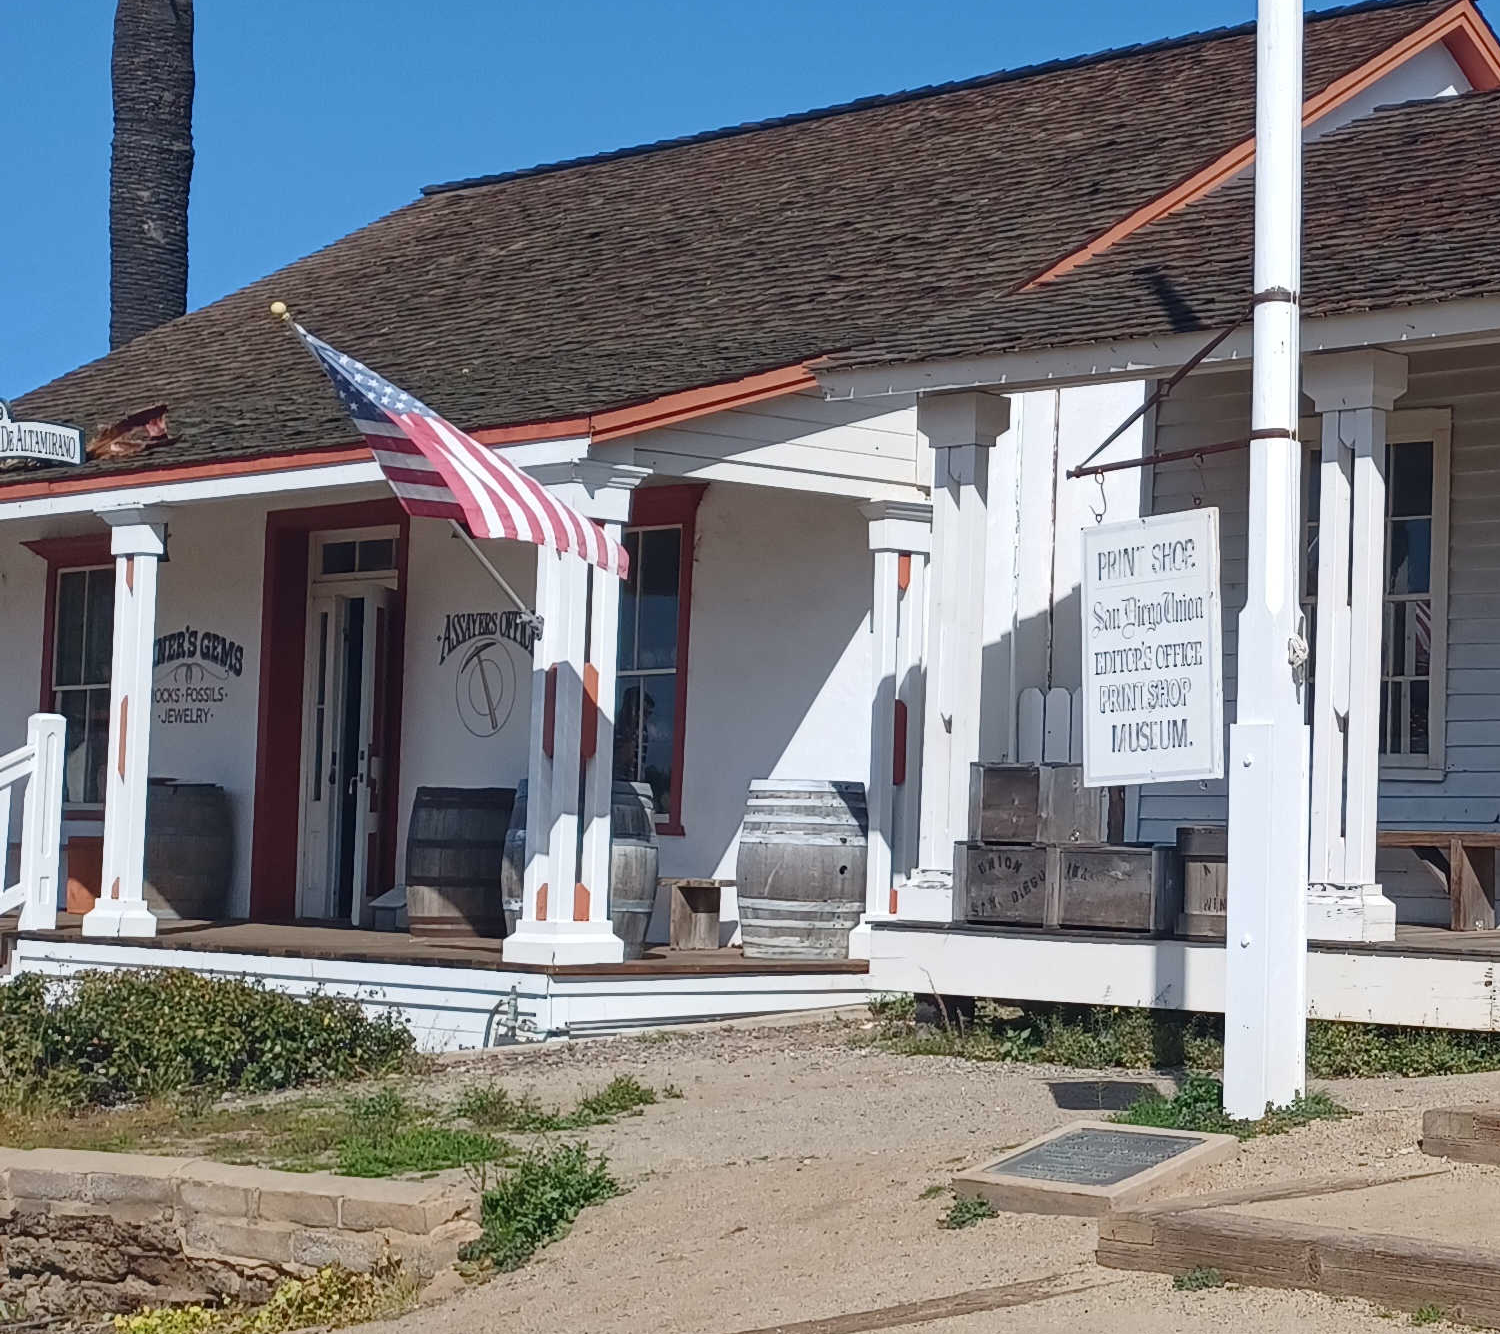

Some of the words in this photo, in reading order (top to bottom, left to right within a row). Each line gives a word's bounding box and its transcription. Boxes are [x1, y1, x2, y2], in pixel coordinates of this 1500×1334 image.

[1097, 546, 1145, 582] PRINT
[1091, 600, 1121, 639] San
[1121, 596, 1163, 640] Diego
[1161, 591, 1204, 624] Union
[154, 625, 198, 668] NER'S
[200, 631, 244, 677] GEMS
[1094, 641, 1153, 676] EDITOR'S
[1155, 641, 1203, 670] OFFICE
[152, 687, 181, 704] OCKS
[185, 687, 225, 703] FOSSILS
[1099, 681, 1146, 714] PRINT
[1146, 676, 1192, 713] SHOP
[161, 707, 211, 724] JEWELRY
[977, 854, 1023, 875] UNION
